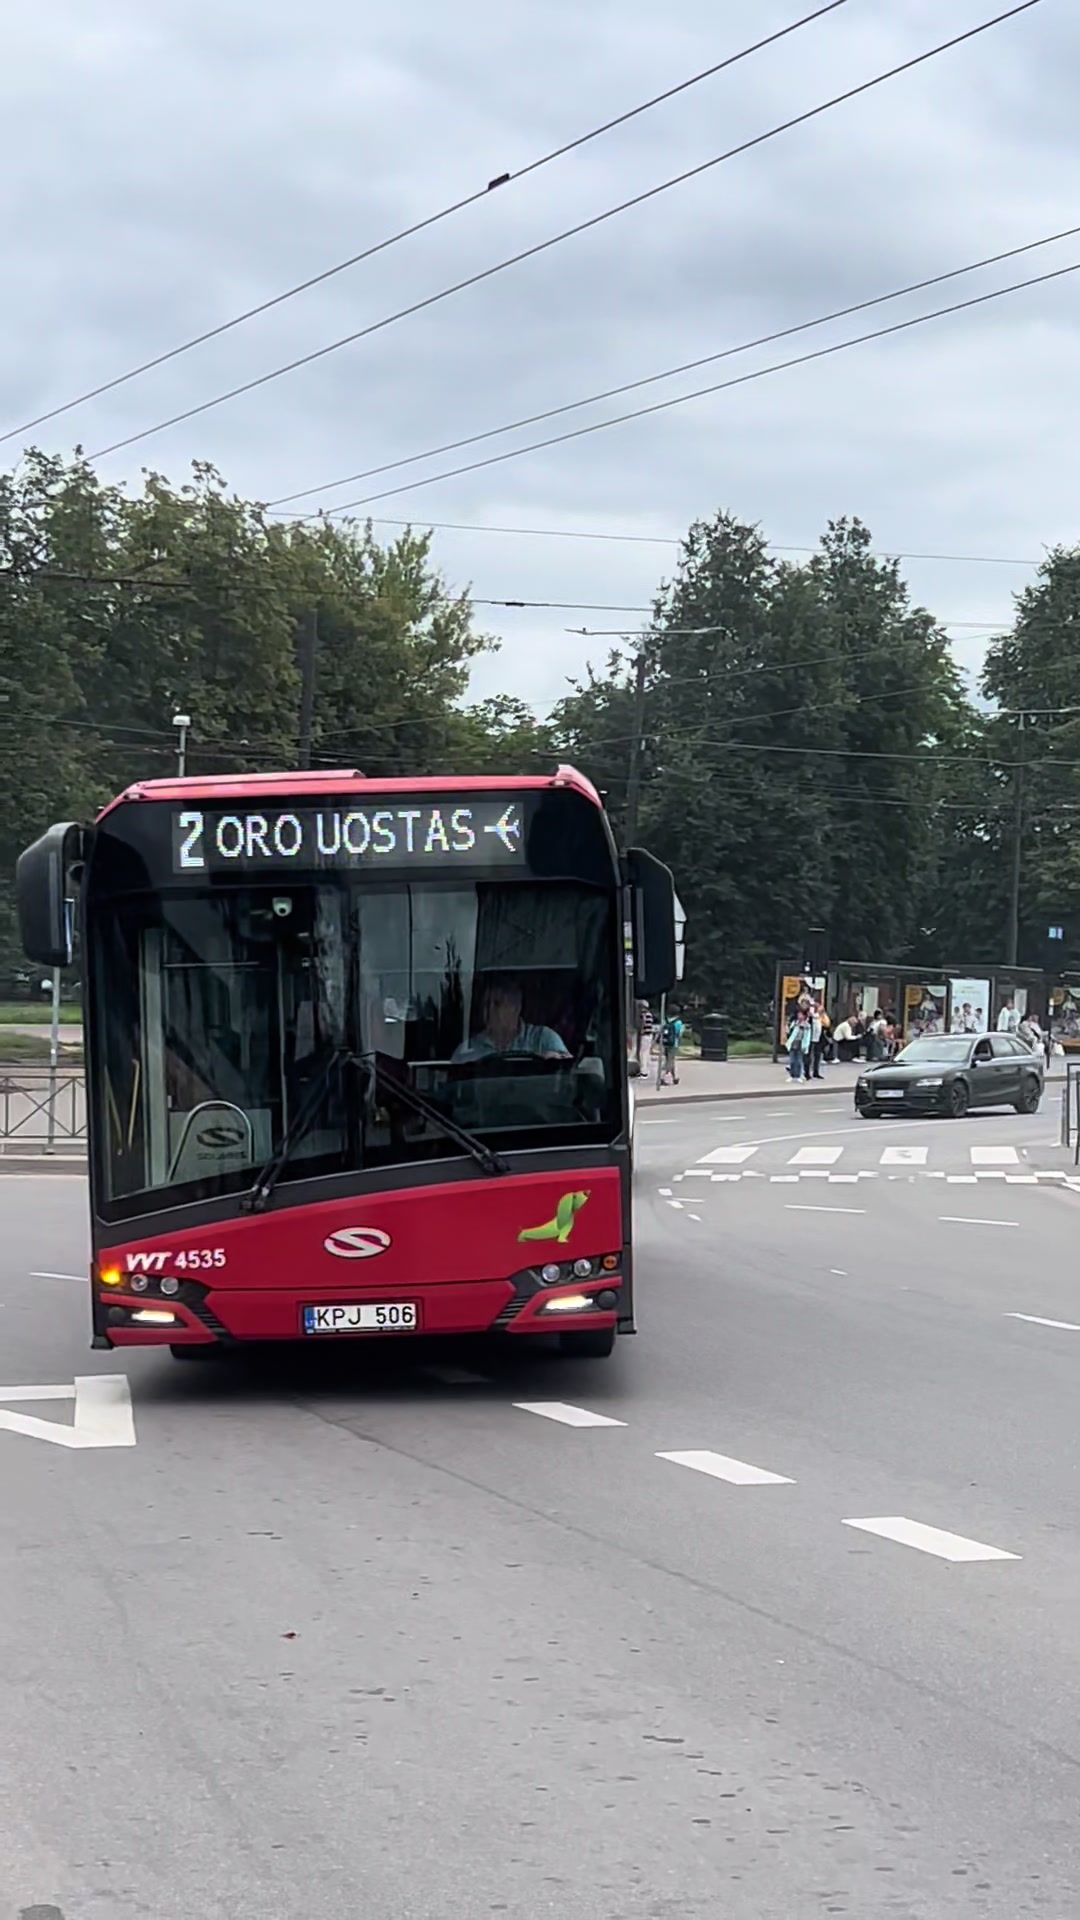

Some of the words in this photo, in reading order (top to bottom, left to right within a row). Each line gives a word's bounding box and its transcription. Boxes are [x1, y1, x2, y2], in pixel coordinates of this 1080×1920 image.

[178, 811, 205, 868] 2
[215, 814, 302, 858] ORO
[316, 808, 476, 855] UOSTAS
[173, 1248, 227, 1270] 4535
[316, 1307, 362, 1327] KPJ
[375, 1305, 414, 1325] 506
